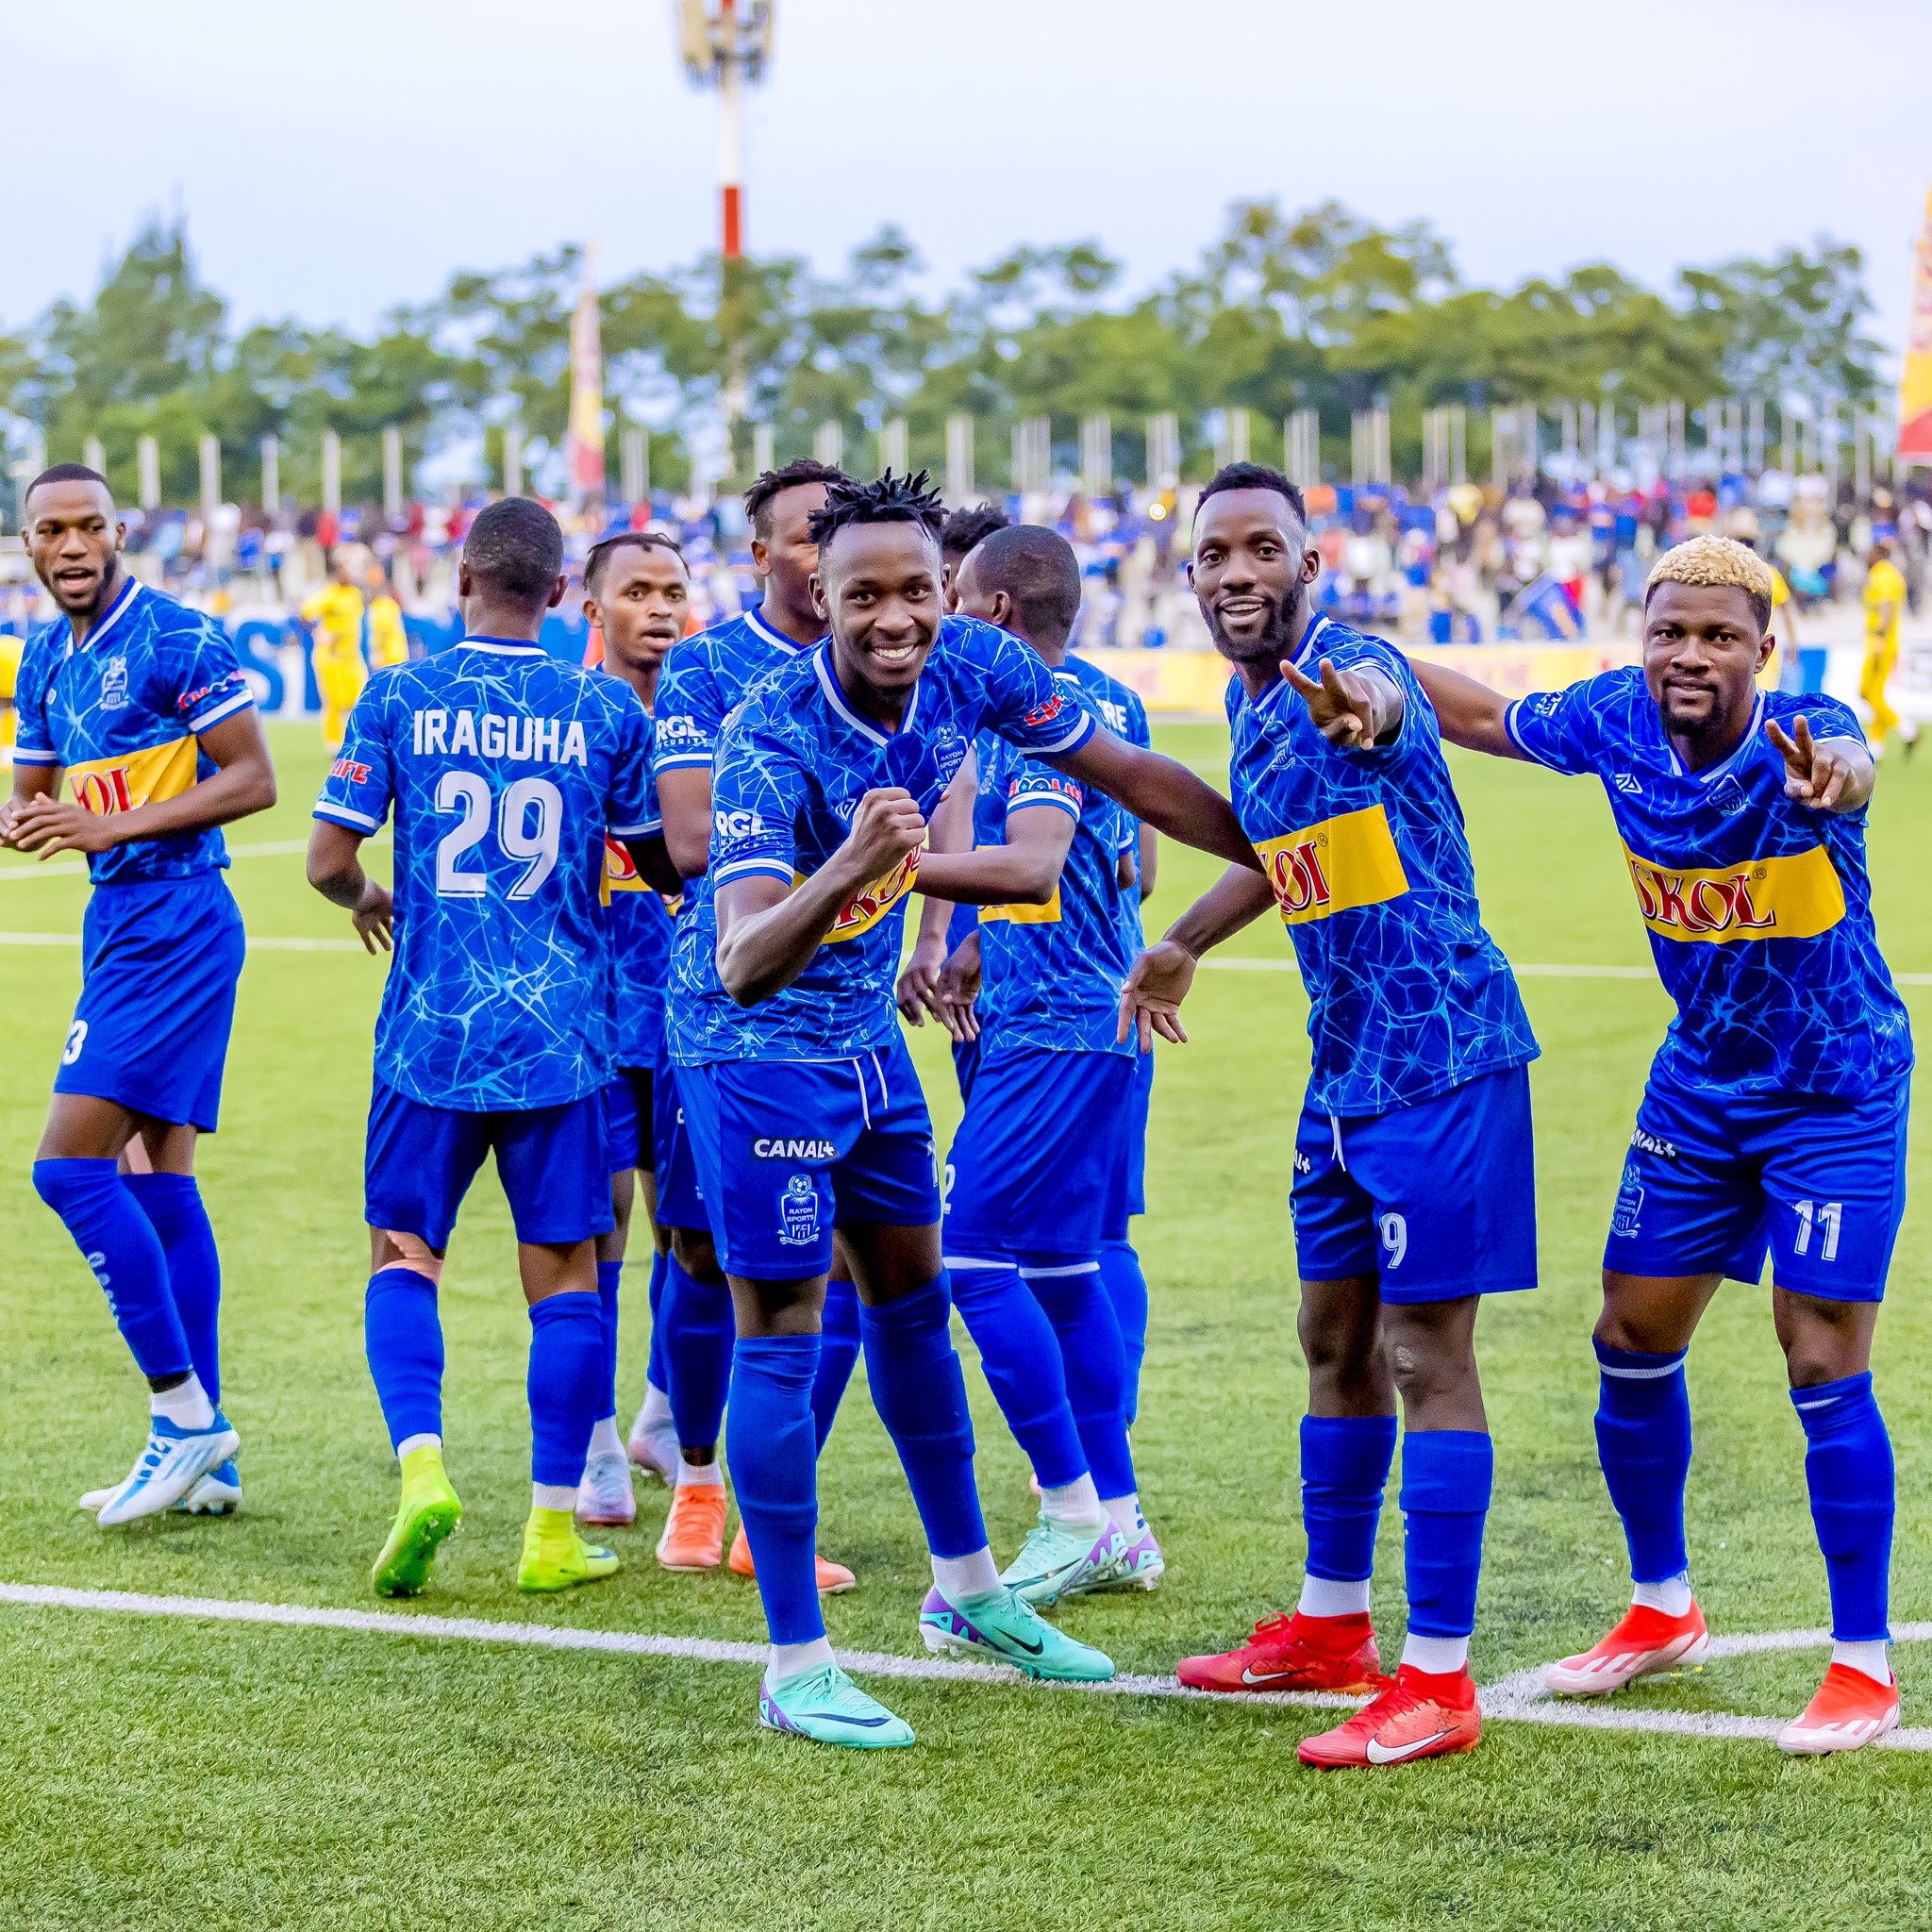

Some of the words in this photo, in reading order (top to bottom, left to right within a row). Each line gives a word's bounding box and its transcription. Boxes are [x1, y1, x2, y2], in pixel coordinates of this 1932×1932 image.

[413, 709, 588, 766] IRAGUHA
[656, 715, 707, 747] RGL
[941, 750, 963, 762] RAYON
[435, 771, 563, 901] 29
[716, 811, 774, 838] RGL
[1631, 859, 1776, 932] SKOL
[61, 1020, 89, 1066] 3
[755, 1139, 835, 1158] CANAL+
[787, 1214, 815, 1223] SPORTS
[1379, 1212, 1407, 1269] 9
[1792, 1199, 1842, 1262] 11
